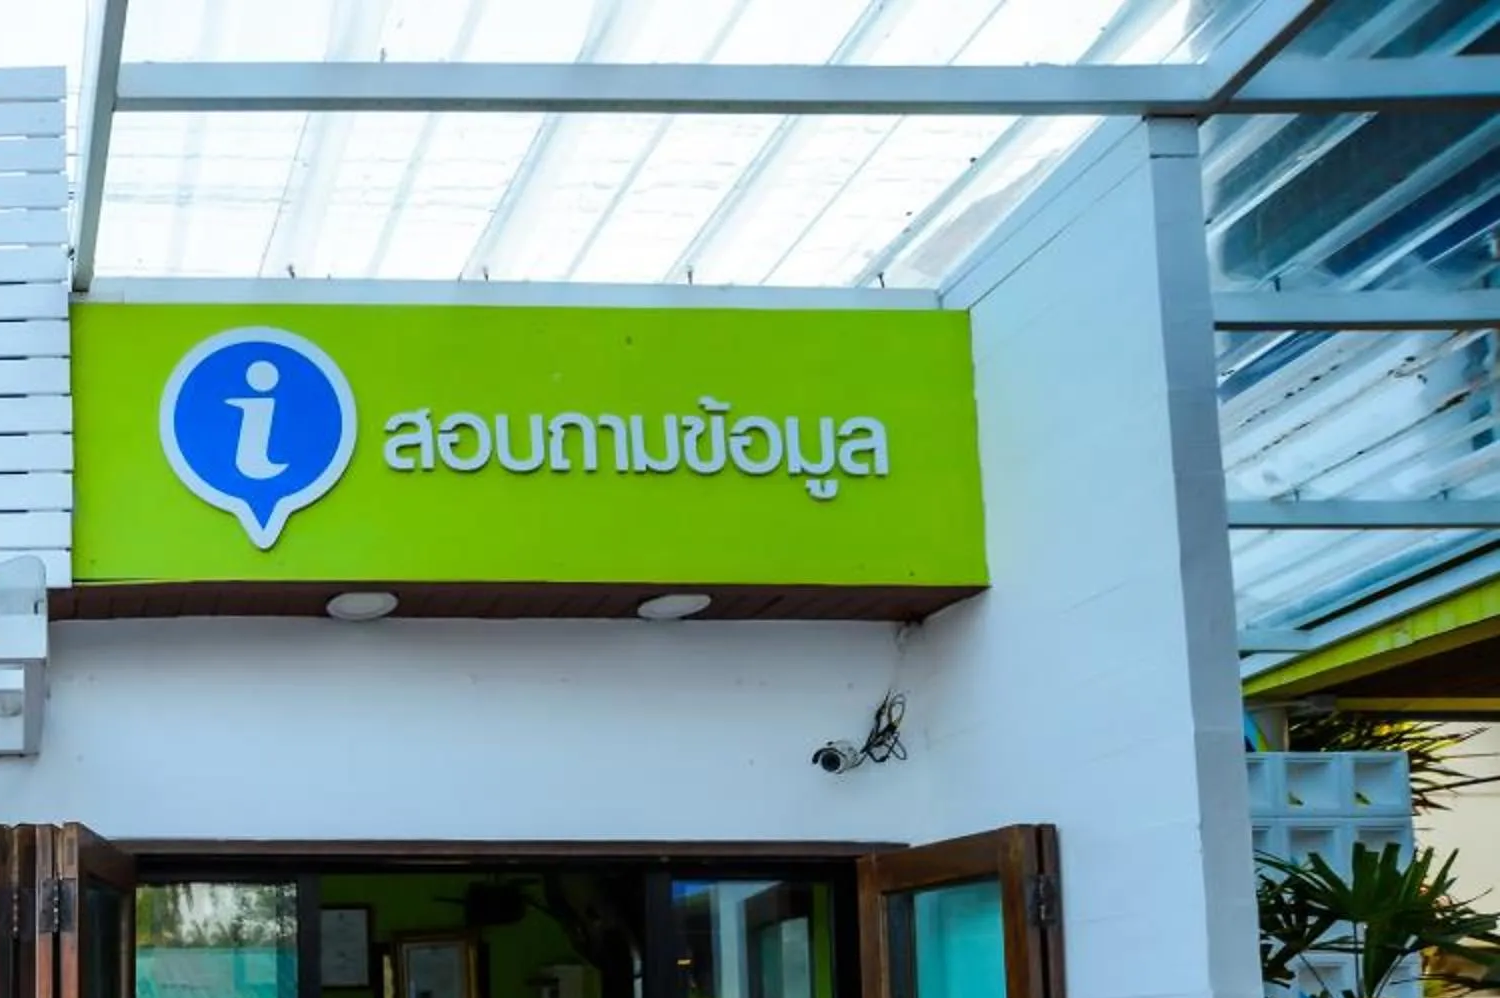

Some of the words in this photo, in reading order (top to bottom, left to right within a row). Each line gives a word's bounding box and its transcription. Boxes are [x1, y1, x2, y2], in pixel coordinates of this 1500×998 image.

[384, 396, 888, 500] สอบถามข้อมูล
